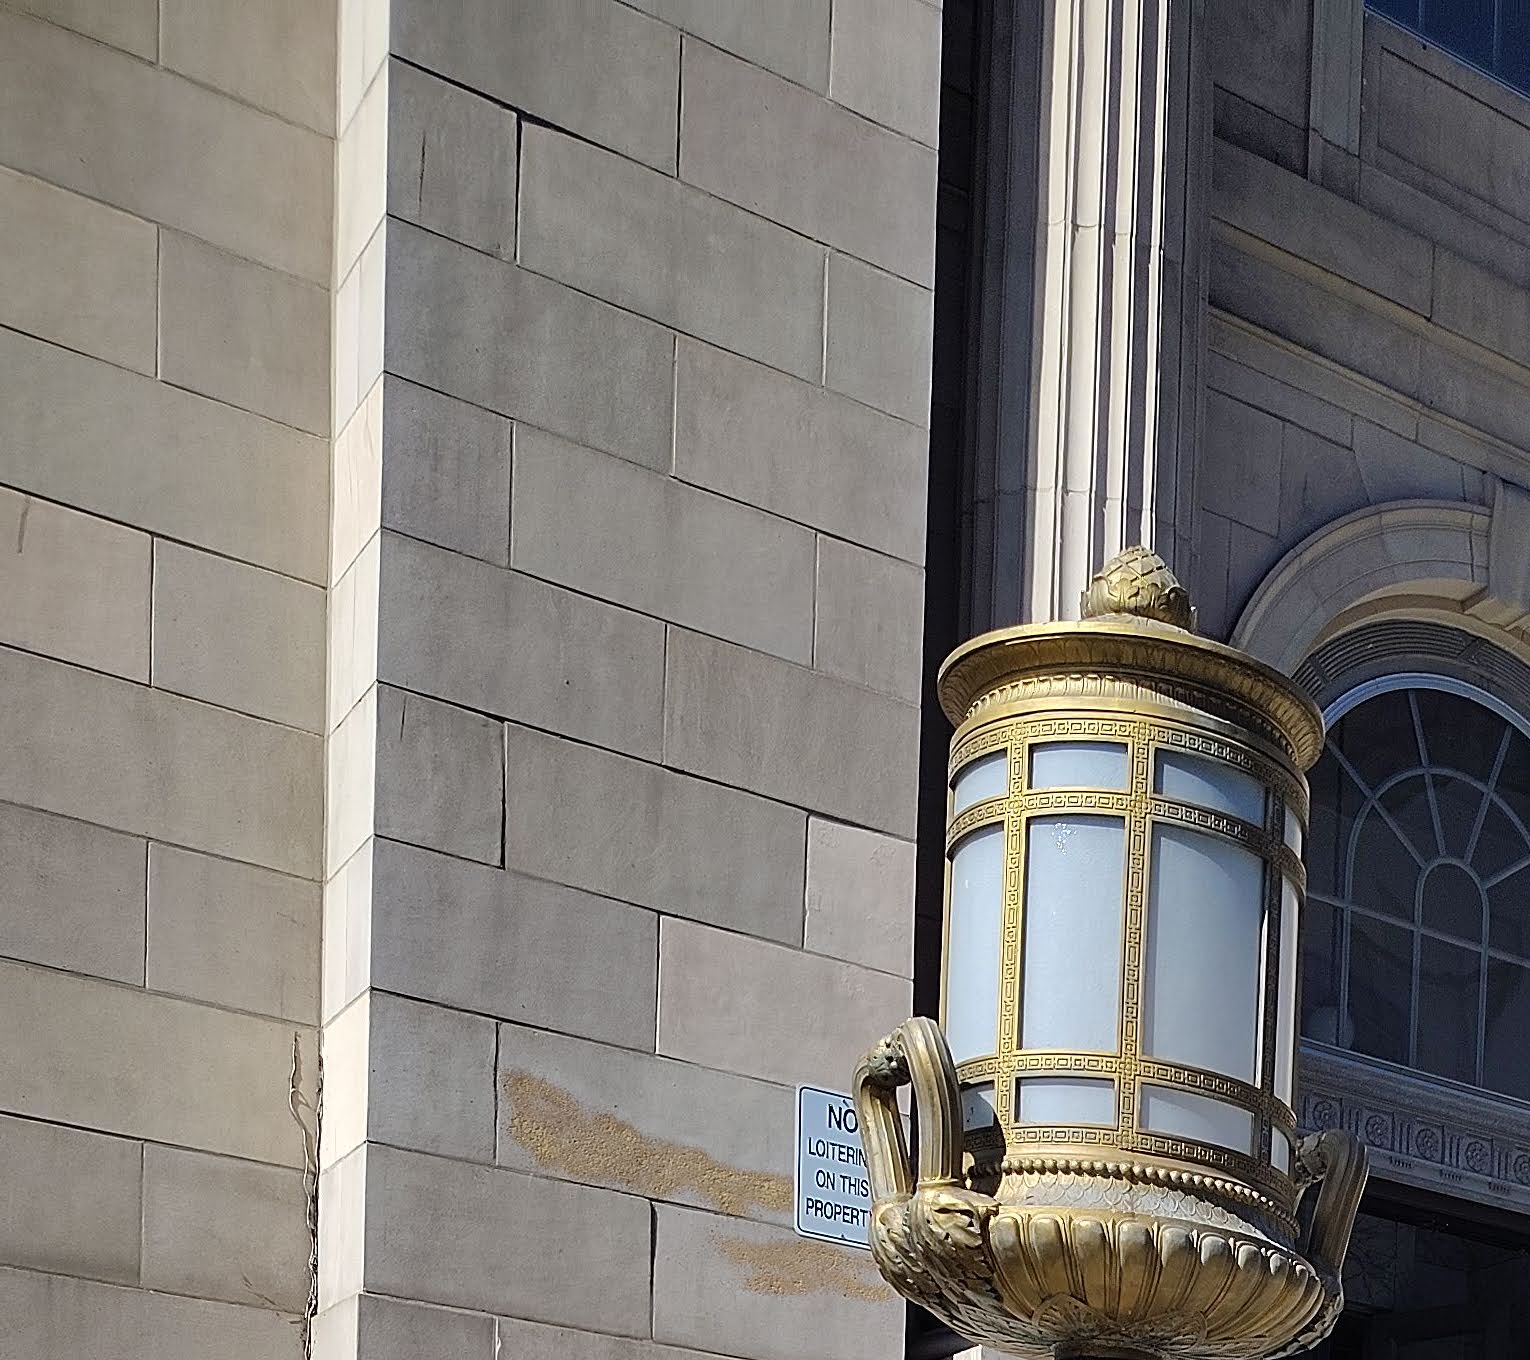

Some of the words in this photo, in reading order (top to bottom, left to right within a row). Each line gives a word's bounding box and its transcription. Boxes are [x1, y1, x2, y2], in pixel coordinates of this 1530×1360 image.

[828, 1104, 859, 1133] NO
[808, 1137, 869, 1168] LOITERIN
[816, 1169, 835, 1190] ON
[840, 1174, 869, 1198] THIS
[806, 1198, 873, 1227] PROPERT
